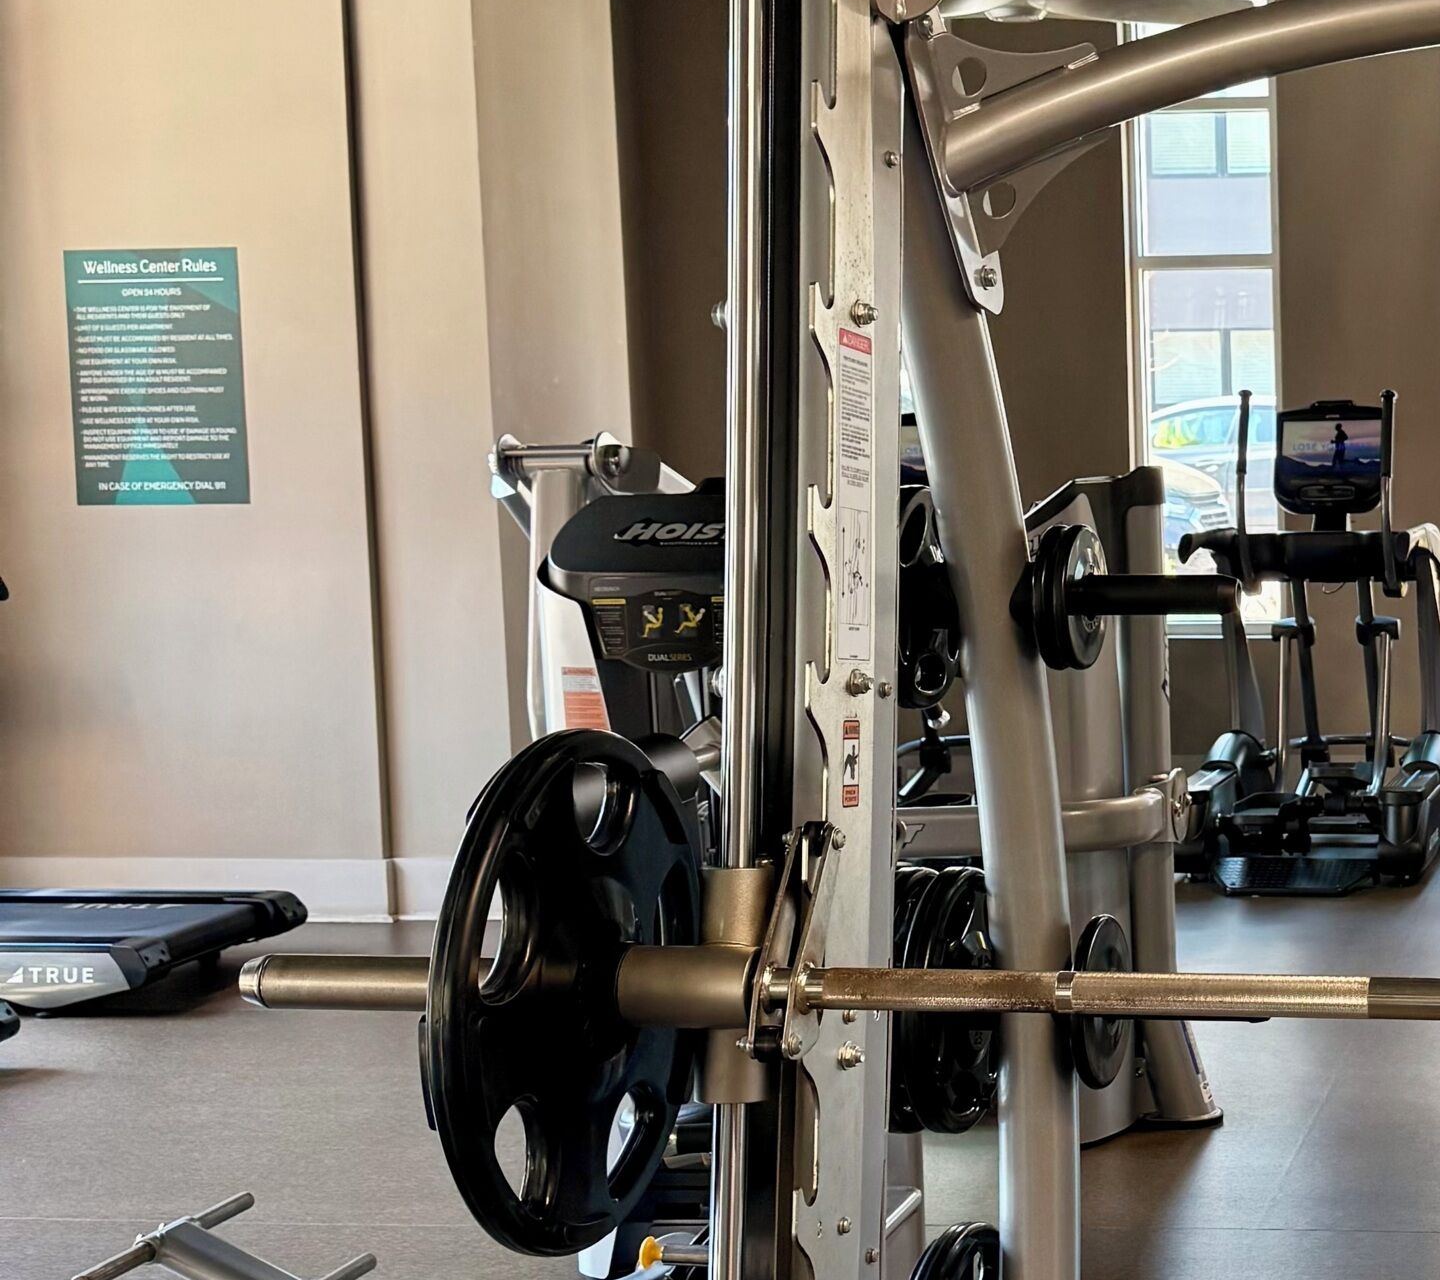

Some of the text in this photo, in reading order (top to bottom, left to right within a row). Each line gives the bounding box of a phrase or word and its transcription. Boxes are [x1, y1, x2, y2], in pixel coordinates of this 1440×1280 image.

[83, 258, 217, 275] Wellness Center Rules
[98, 481, 108, 491] IN
[109, 481, 130, 491] CASE
[131, 481, 143, 491] OF
[143, 481, 195, 490] EMERGENCY
[195, 480, 214, 490] DIAL
[623, 522, 726, 541] HOIS
[28, 966, 95, 984] TRUE
